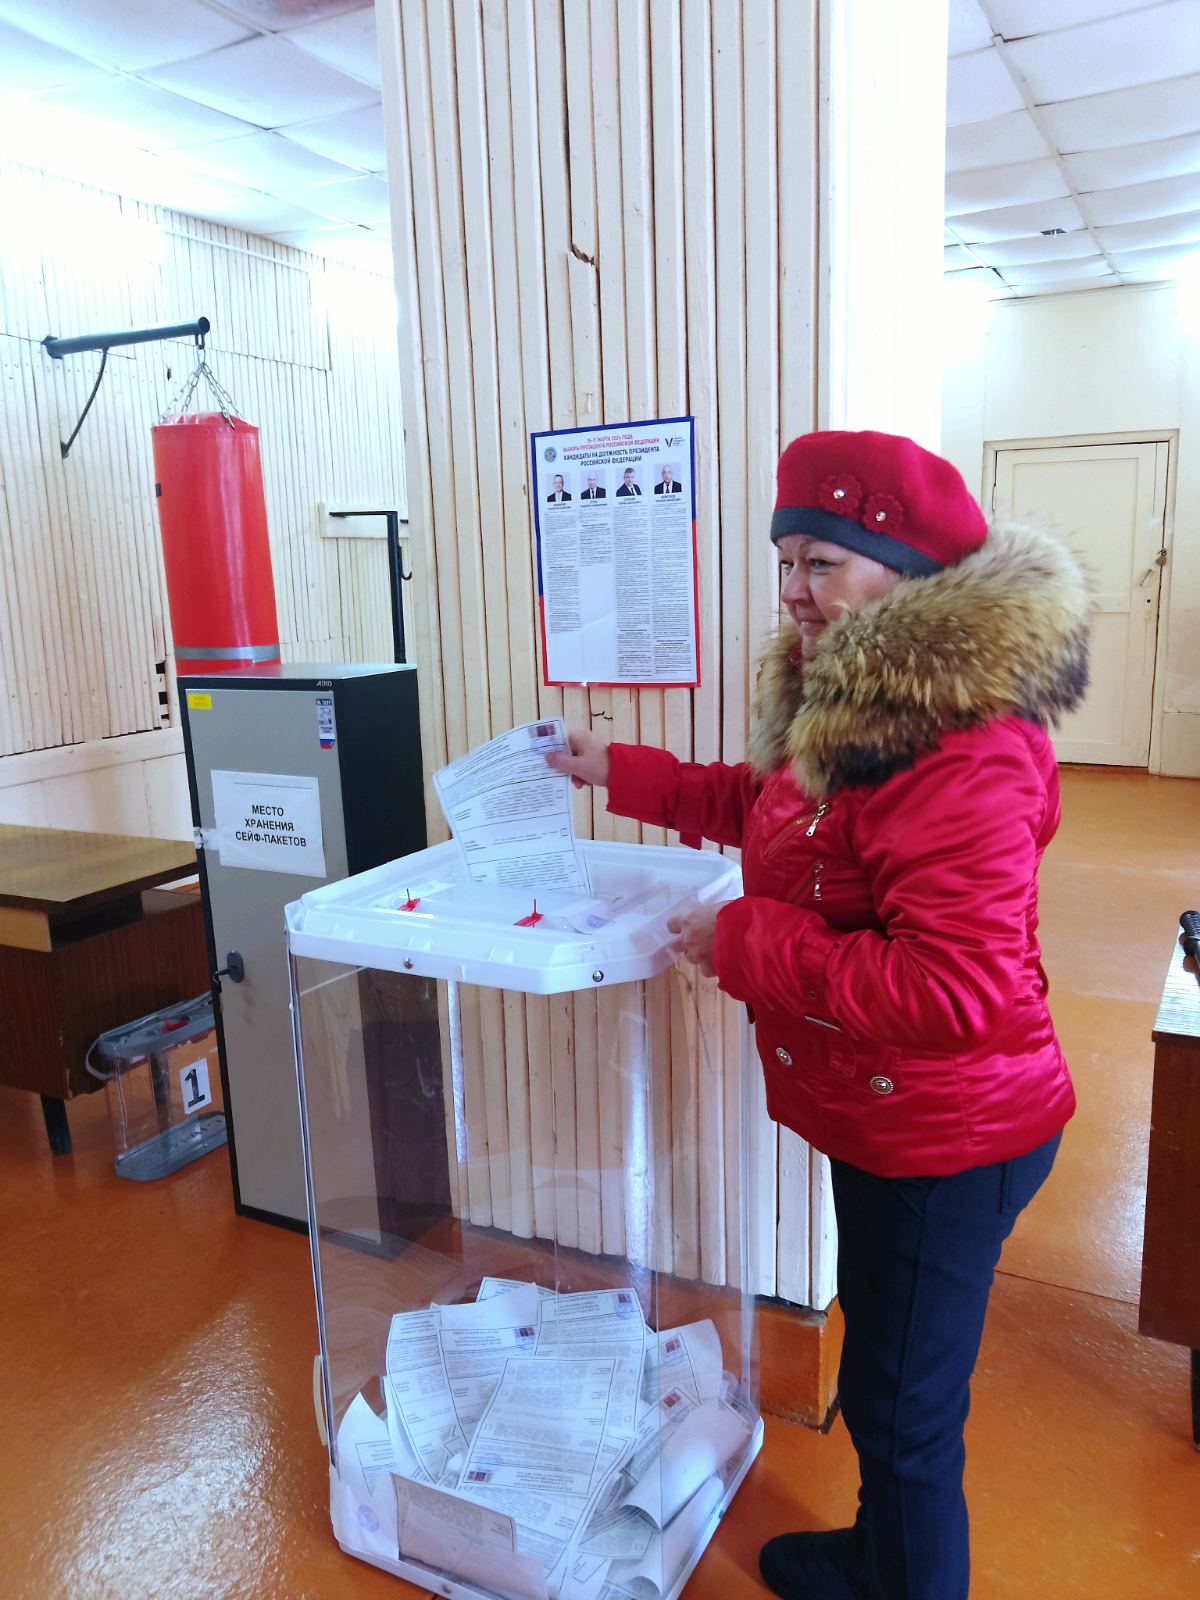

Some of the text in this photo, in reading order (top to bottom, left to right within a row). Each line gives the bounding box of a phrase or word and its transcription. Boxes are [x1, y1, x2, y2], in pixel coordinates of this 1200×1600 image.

[605, 440, 634, 449] РОССИЙСКОЙ
[634, 438, 660, 446] ФЕДЕРАЦИИ
[563, 451, 592, 461] КАНДИДАТЫ
[598, 449, 628, 458] ДОЛЖНОСТЬ
[629, 446, 660, 455] ПРЕЗИДЕНТА
[580, 456, 642, 467] РОССИЙСКОЙ ФЕДЕРАЦИИ
[251, 804, 284, 817] МЕСТО
[244, 817, 295, 832] ХРАНЕНИЯ
[235, 830, 307, 847] СЕЙФ-ПАКЕТОВ
[184, 1068, 206, 1108] 1
